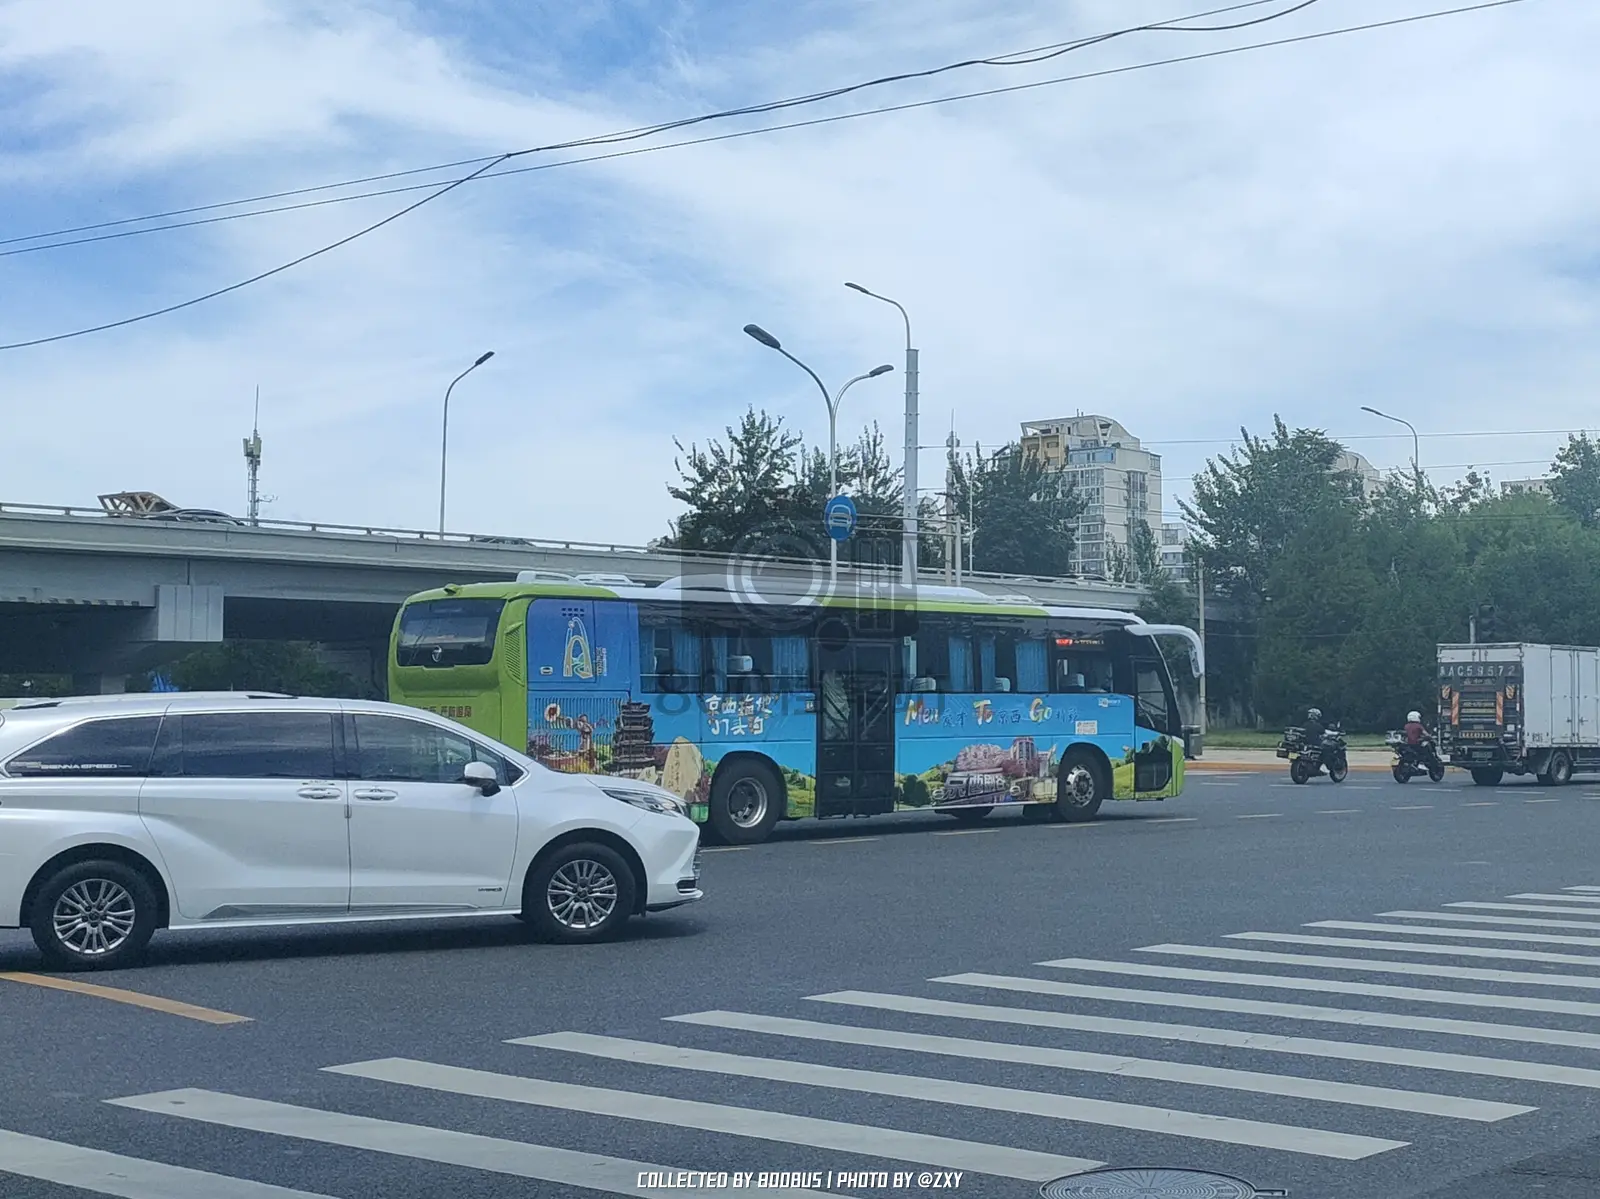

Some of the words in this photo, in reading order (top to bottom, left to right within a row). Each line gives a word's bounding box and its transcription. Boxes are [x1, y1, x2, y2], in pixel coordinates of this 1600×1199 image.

[904, 699, 939, 726] Men
[973, 699, 994, 726] To
[1029, 698, 1052, 723] Go
